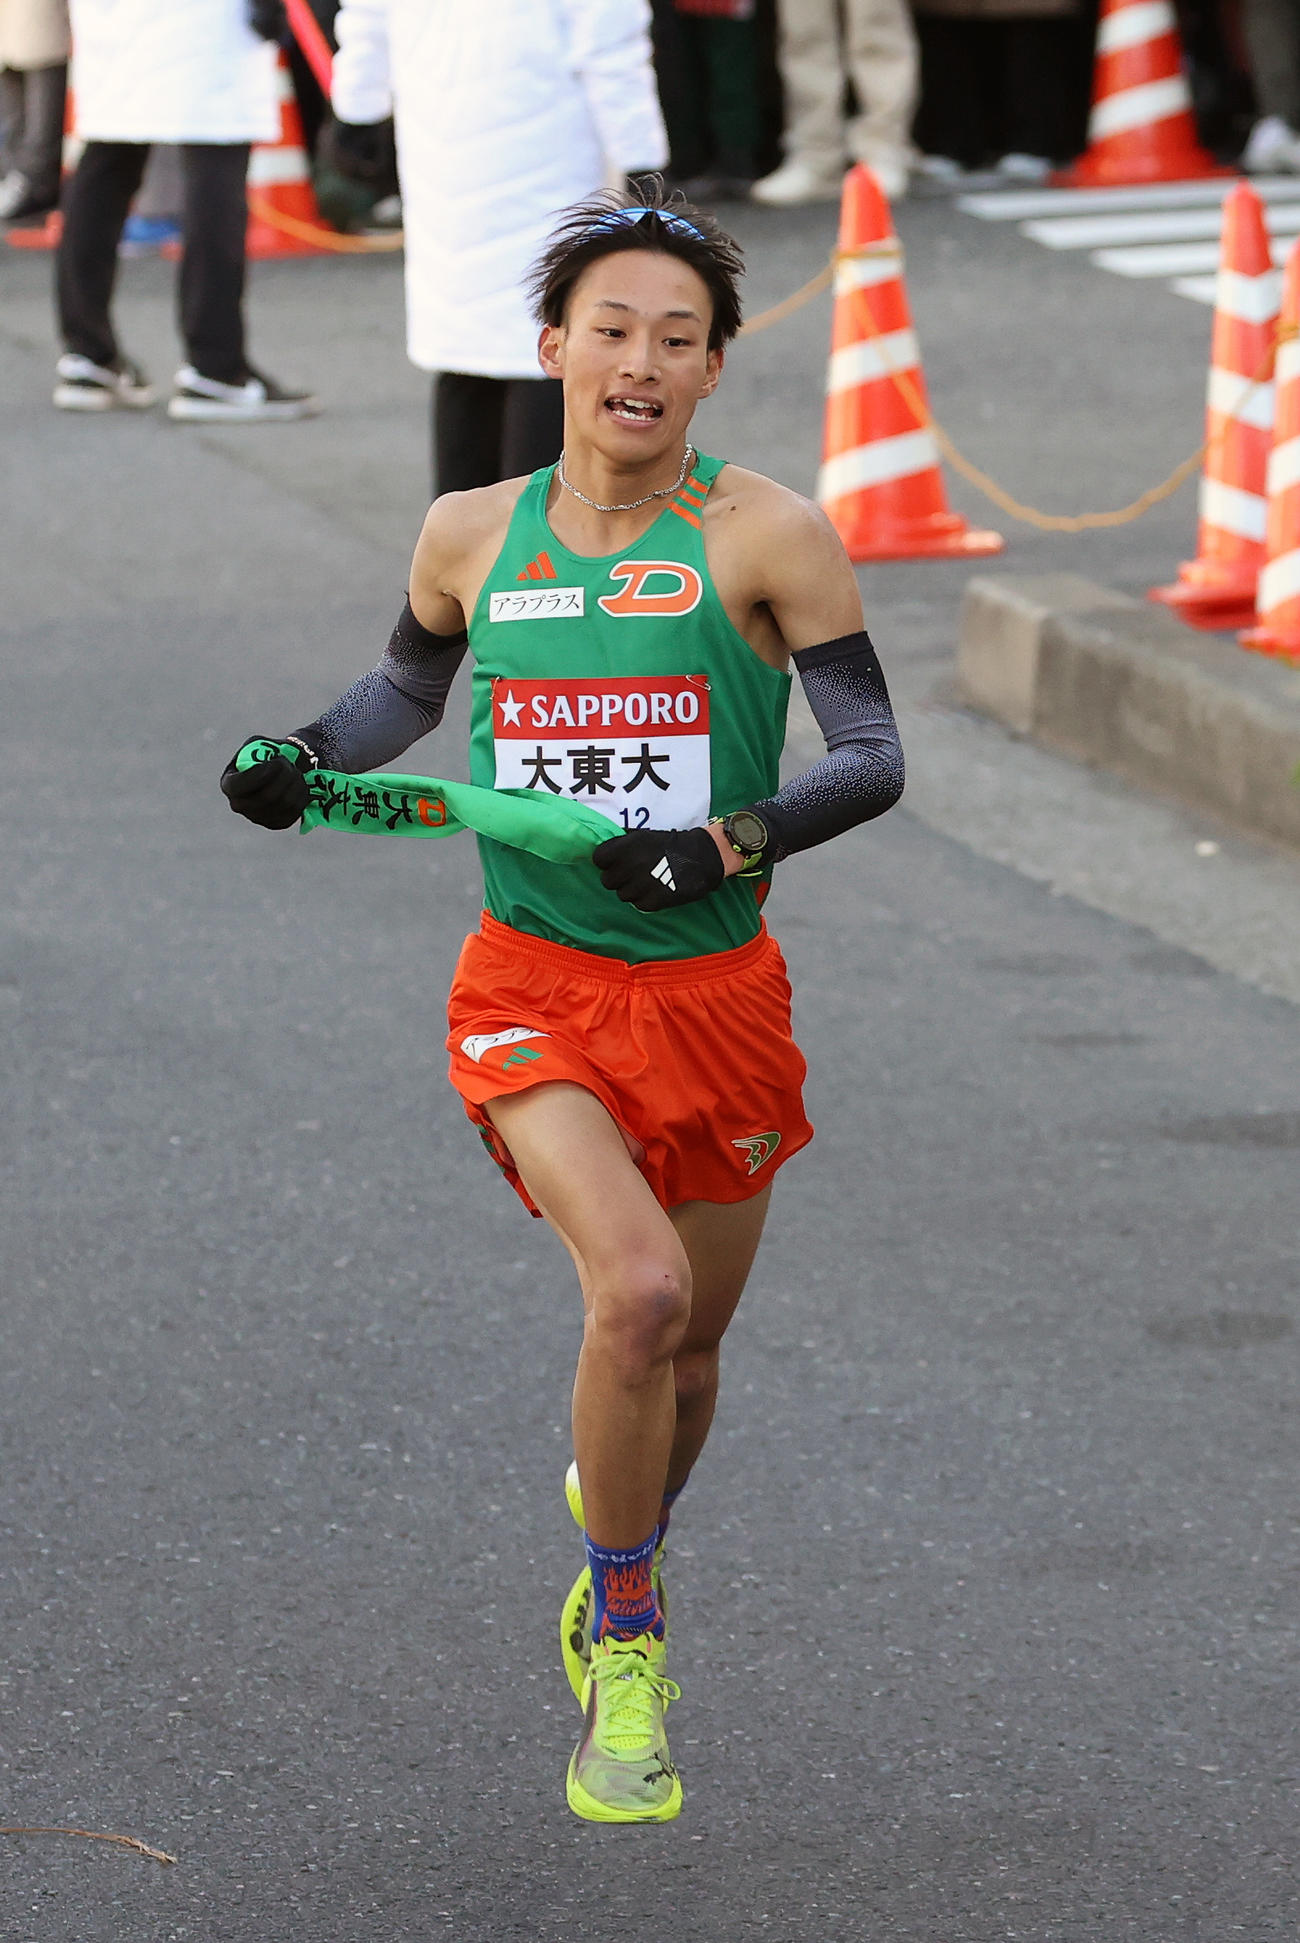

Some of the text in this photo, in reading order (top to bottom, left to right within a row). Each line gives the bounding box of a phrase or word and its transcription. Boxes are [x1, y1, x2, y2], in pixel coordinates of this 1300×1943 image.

[493, 593, 580, 616] アラプラス
[597, 560, 703, 617] D
[530, 690, 699, 728] SAPPORO
[521, 743, 671, 795] 大東大
[619, 806, 651, 829] 12
